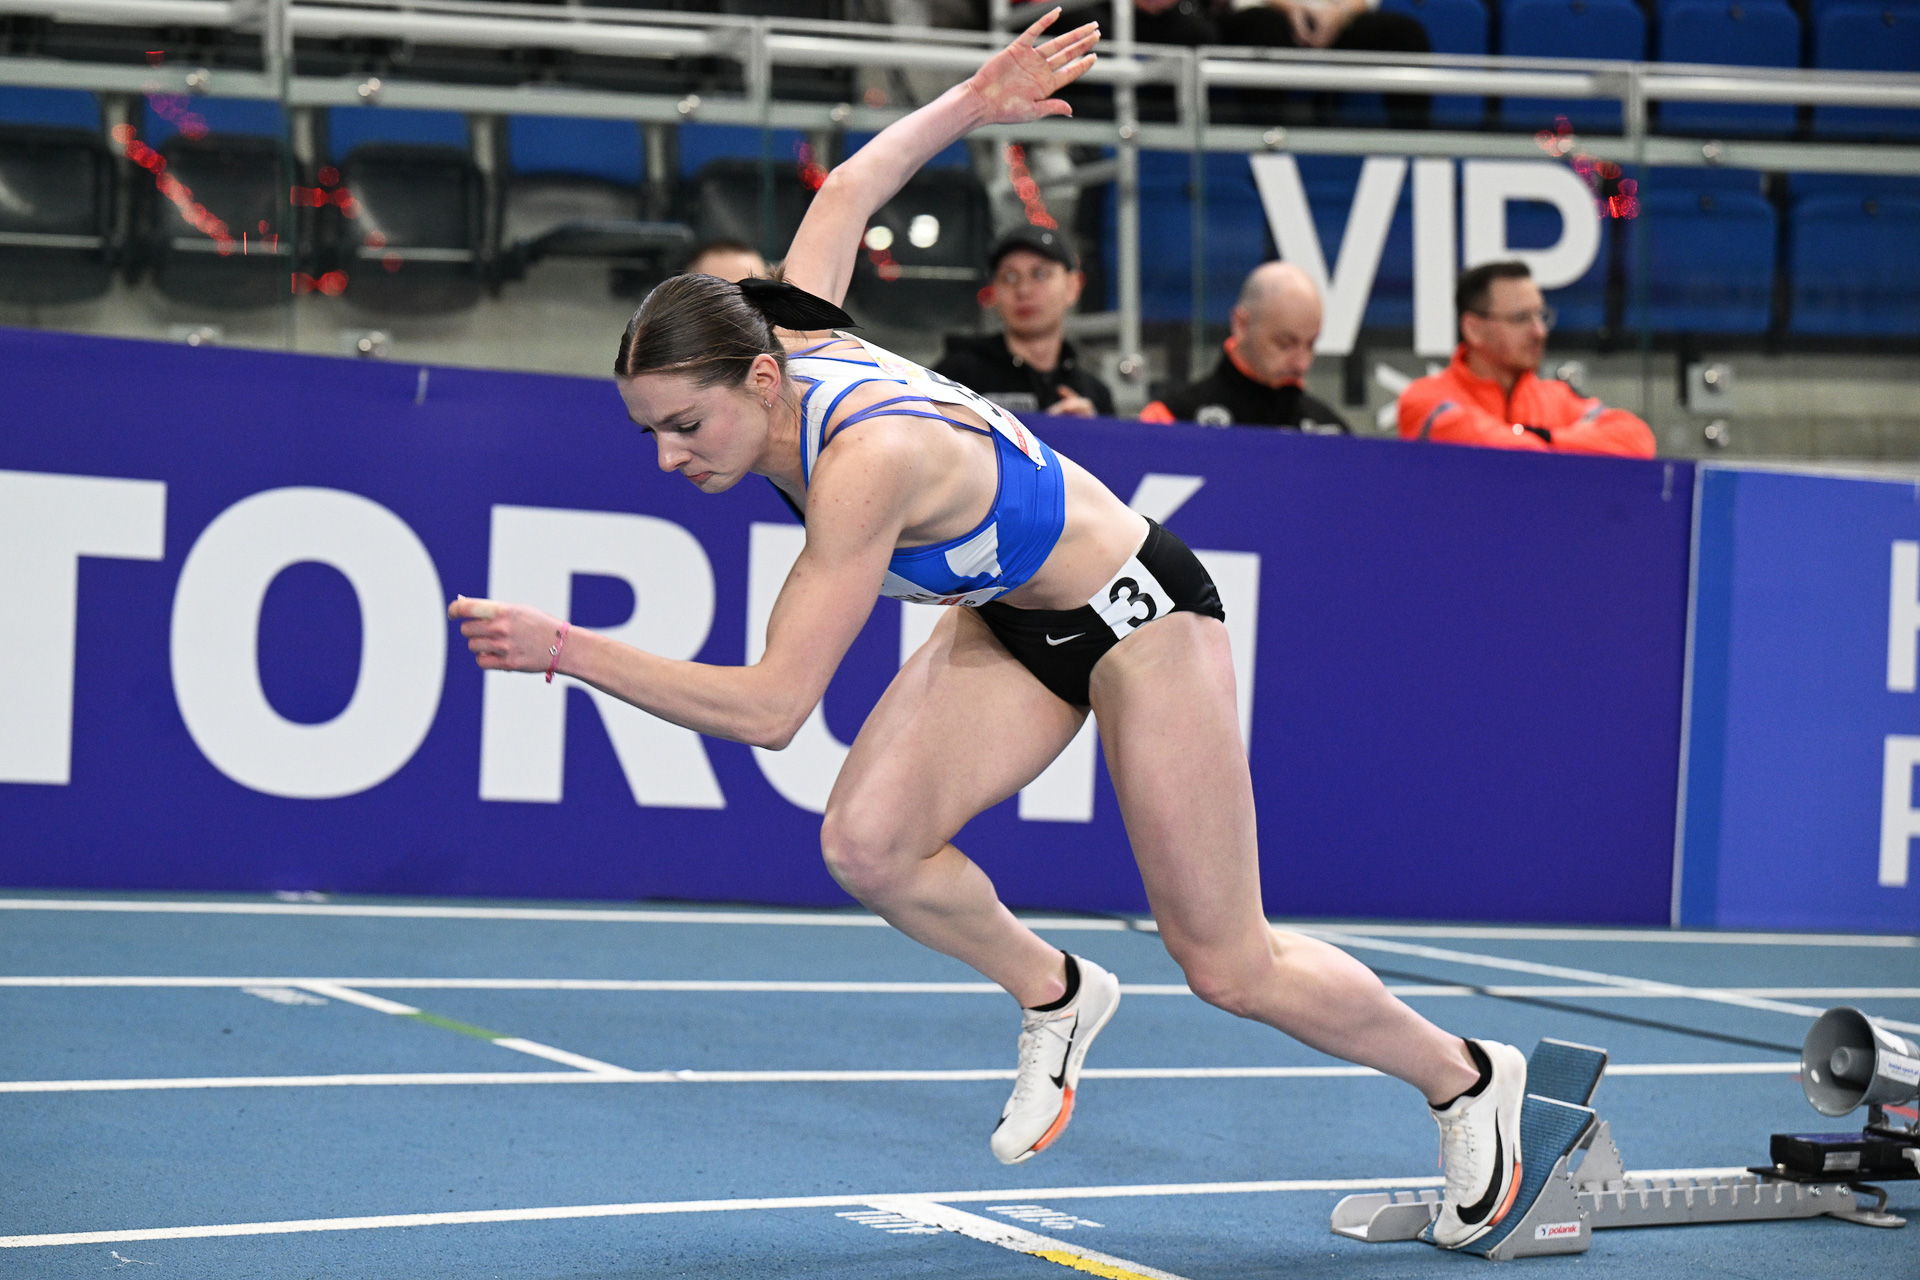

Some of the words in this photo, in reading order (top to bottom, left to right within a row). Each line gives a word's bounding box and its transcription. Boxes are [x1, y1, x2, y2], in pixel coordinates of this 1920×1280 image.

[1248, 154, 1602, 356] VIP
[0, 470, 1260, 822] TOR
[1108, 577, 1158, 628] 3
[1548, 1224, 1577, 1236] polanik
